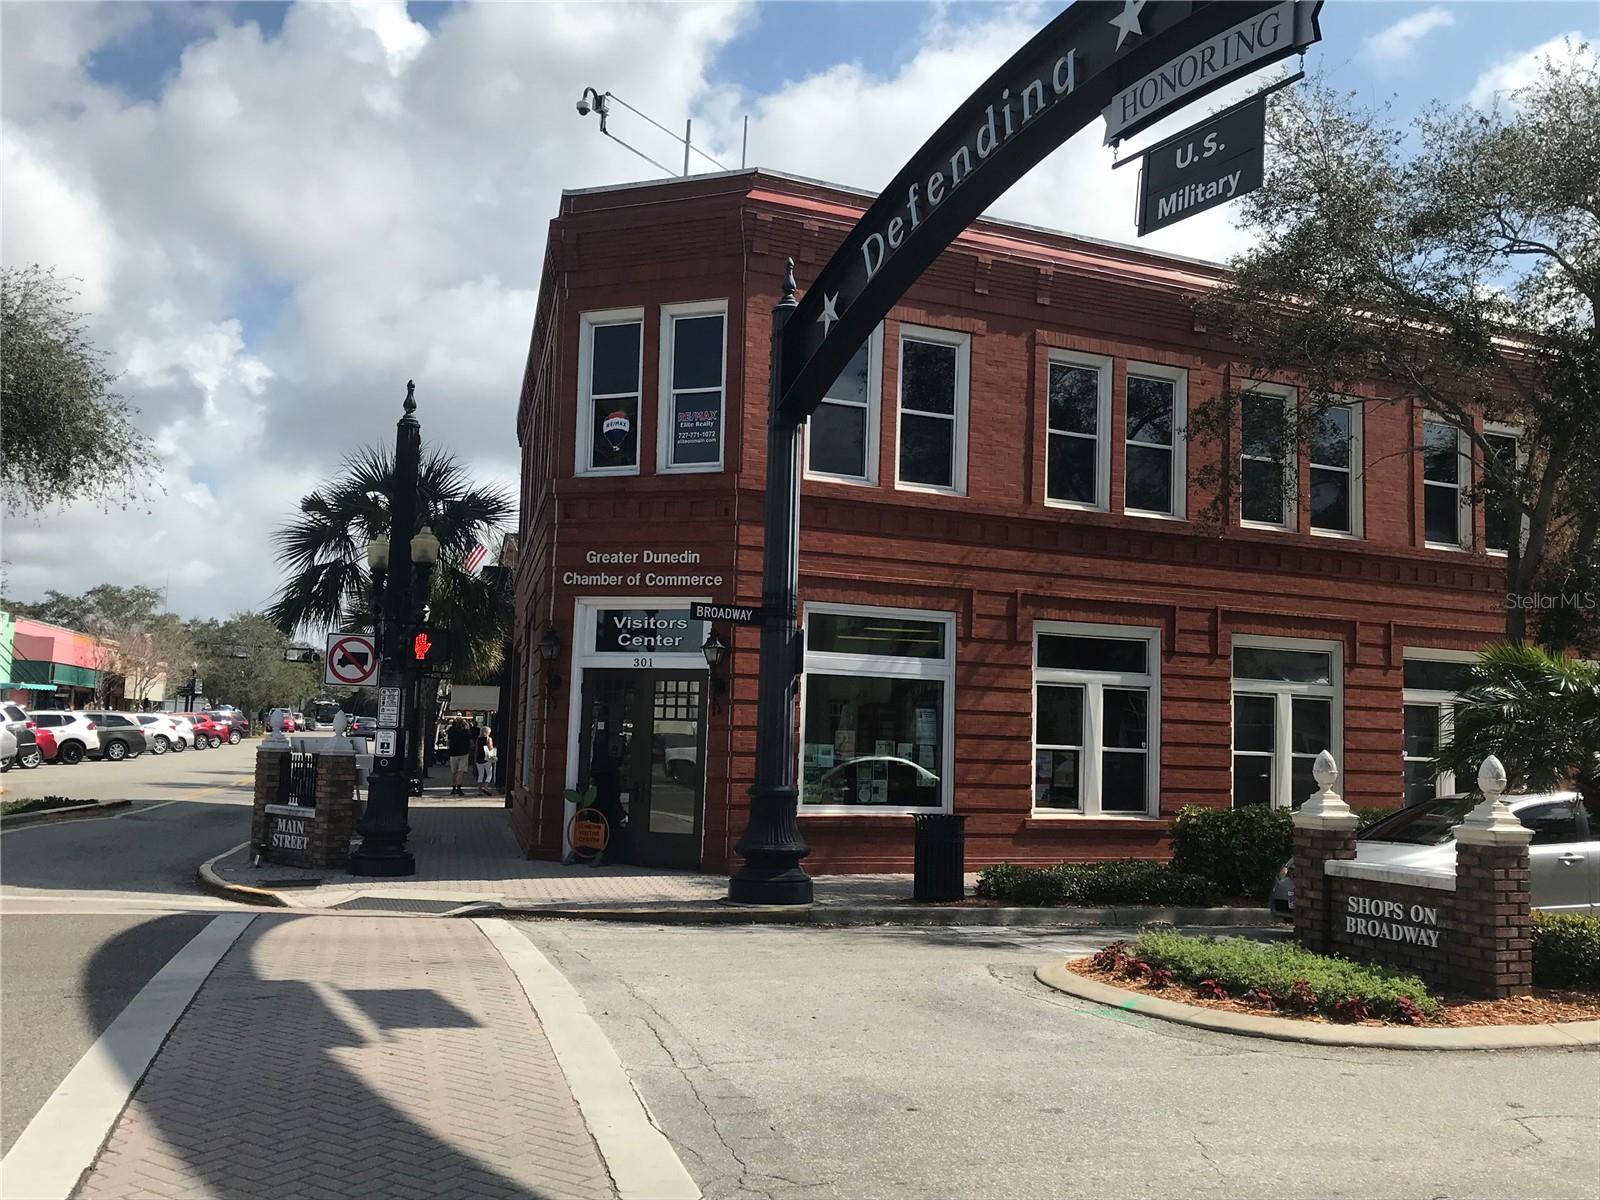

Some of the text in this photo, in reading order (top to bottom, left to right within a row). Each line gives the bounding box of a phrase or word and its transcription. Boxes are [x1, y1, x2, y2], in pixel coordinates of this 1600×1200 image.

[1120, 11, 1281, 124] HONORING
[1175, 132, 1226, 169] U.S.
[861, 47, 1077, 283] Defending
[1157, 170, 1242, 219] Military
[678, 410, 718, 422] RE/MAX
[586, 550, 701, 564] Greater Dunedin
[563, 571, 723, 586] Chamber of Commerce
[696, 605, 753, 621] BROADWAY
[613, 615, 688, 629] Visitors
[617, 633, 683, 646] Center
[633, 657, 653, 667] 301
[277, 818, 305, 834] MAIN
[272, 833, 310, 850] STREET
[1348, 896, 1438, 926] SHOPS ON
[1346, 916, 1441, 948] BROADWAY
